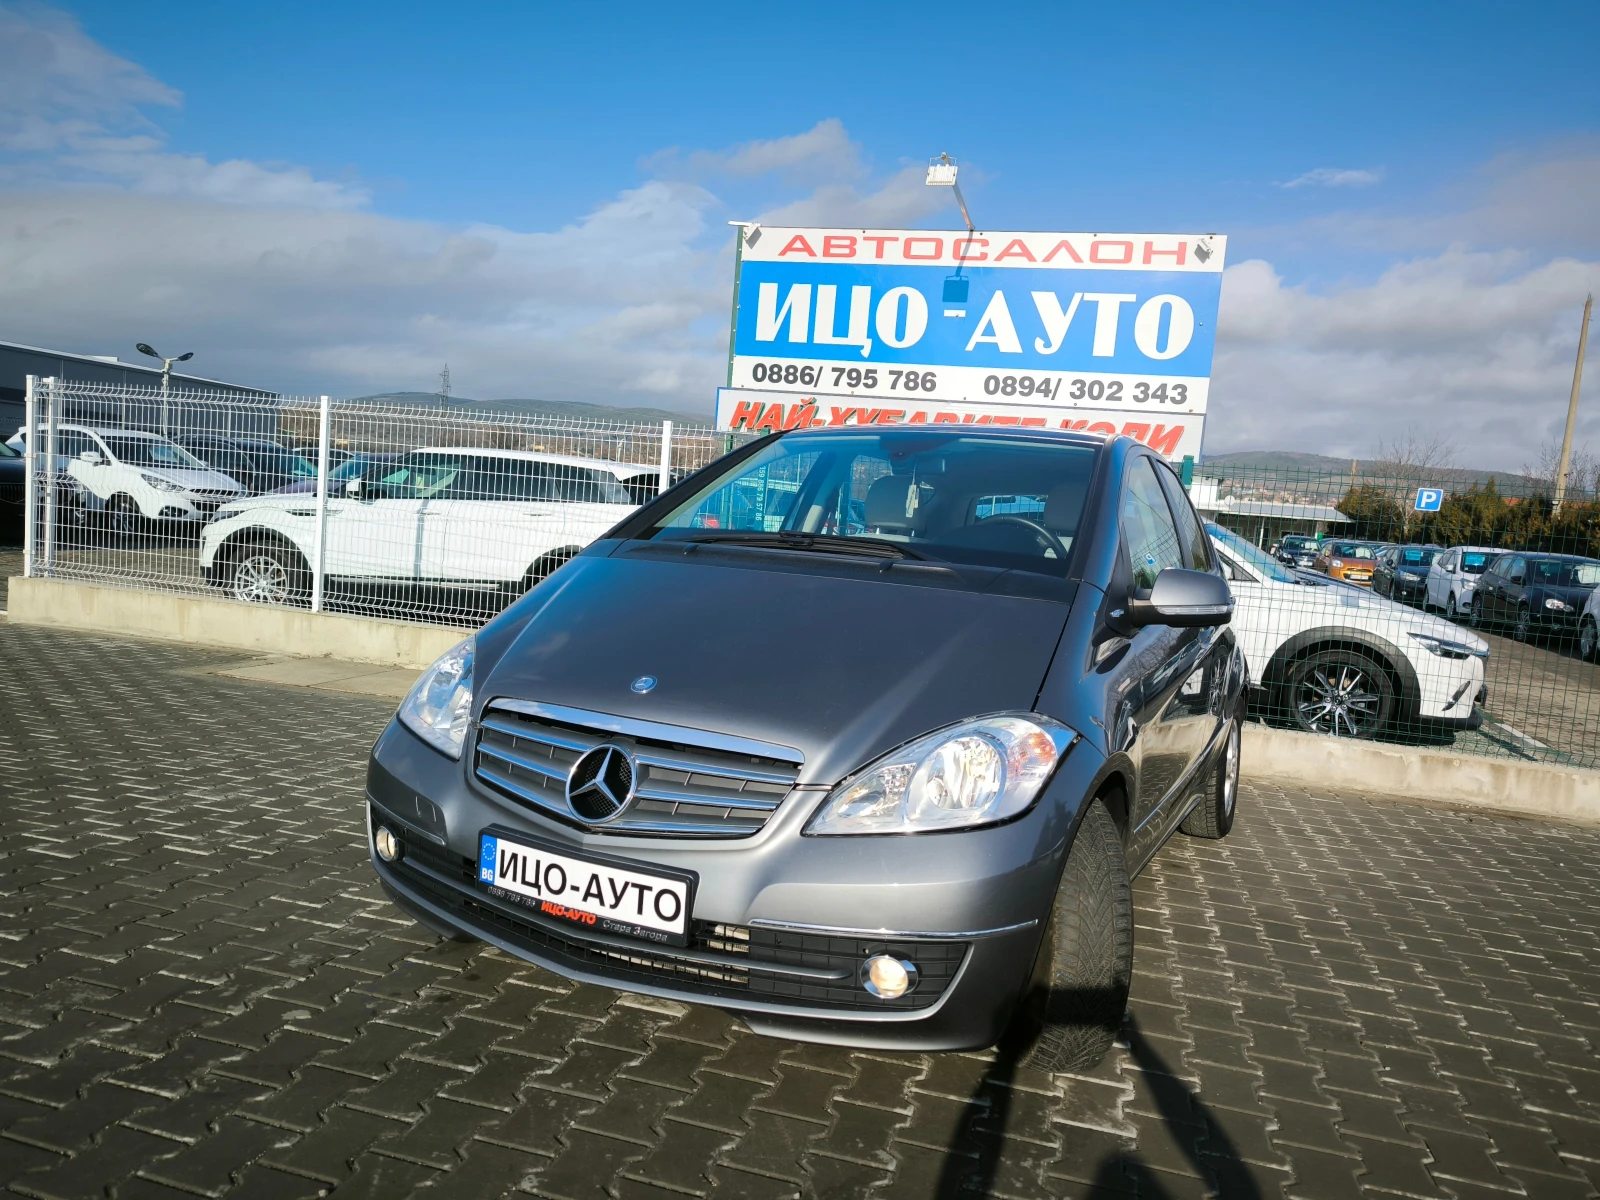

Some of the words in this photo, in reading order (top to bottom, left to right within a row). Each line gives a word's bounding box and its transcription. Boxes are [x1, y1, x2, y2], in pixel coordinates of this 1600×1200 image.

[778, 234, 1187, 265] АВТОСАЛОН
[752, 362, 823, 388] 0886/
[831, 366, 878, 389] 795
[888, 369, 937, 392] 786
[983, 374, 1062, 401] 0894/
[1069, 378, 1124, 404] 302
[1132, 382, 1188, 405] 343
[1420, 491, 1437, 508] P
[481, 867, 494, 881] BG
[498, 848, 682, 922] ИЦО-АУТО
[541, 901, 597, 925] ИЦО-АУТО
[602, 919, 632, 933] Стара
[633, 926, 668, 942] Загора
